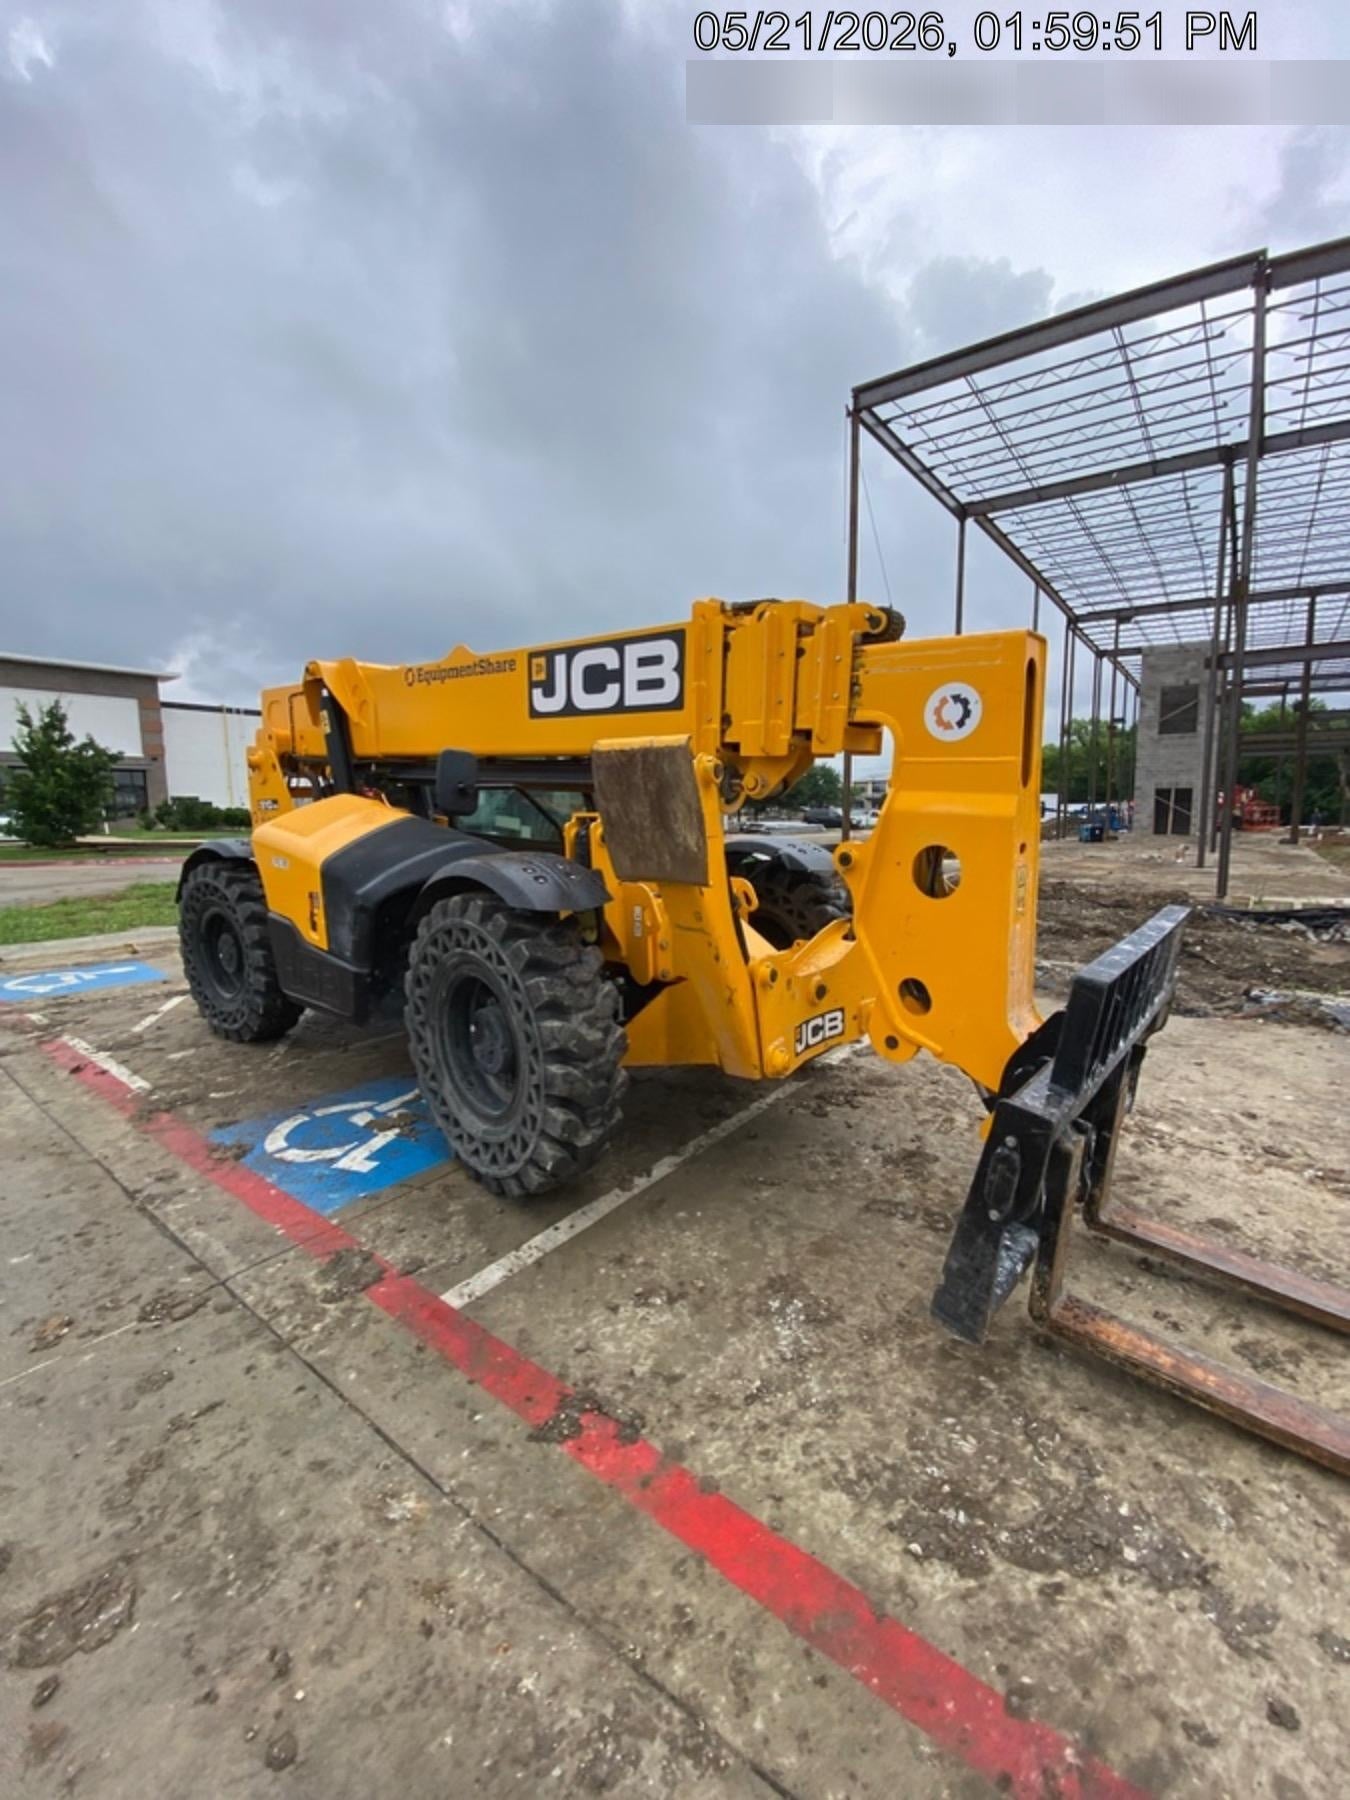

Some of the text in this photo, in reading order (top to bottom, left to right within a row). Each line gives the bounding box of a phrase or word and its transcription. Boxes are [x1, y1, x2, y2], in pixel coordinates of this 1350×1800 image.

[416, 658, 517, 685] EquipmentShare
[531, 638, 681, 713] JCB
[795, 1009, 844, 1053] JCB
